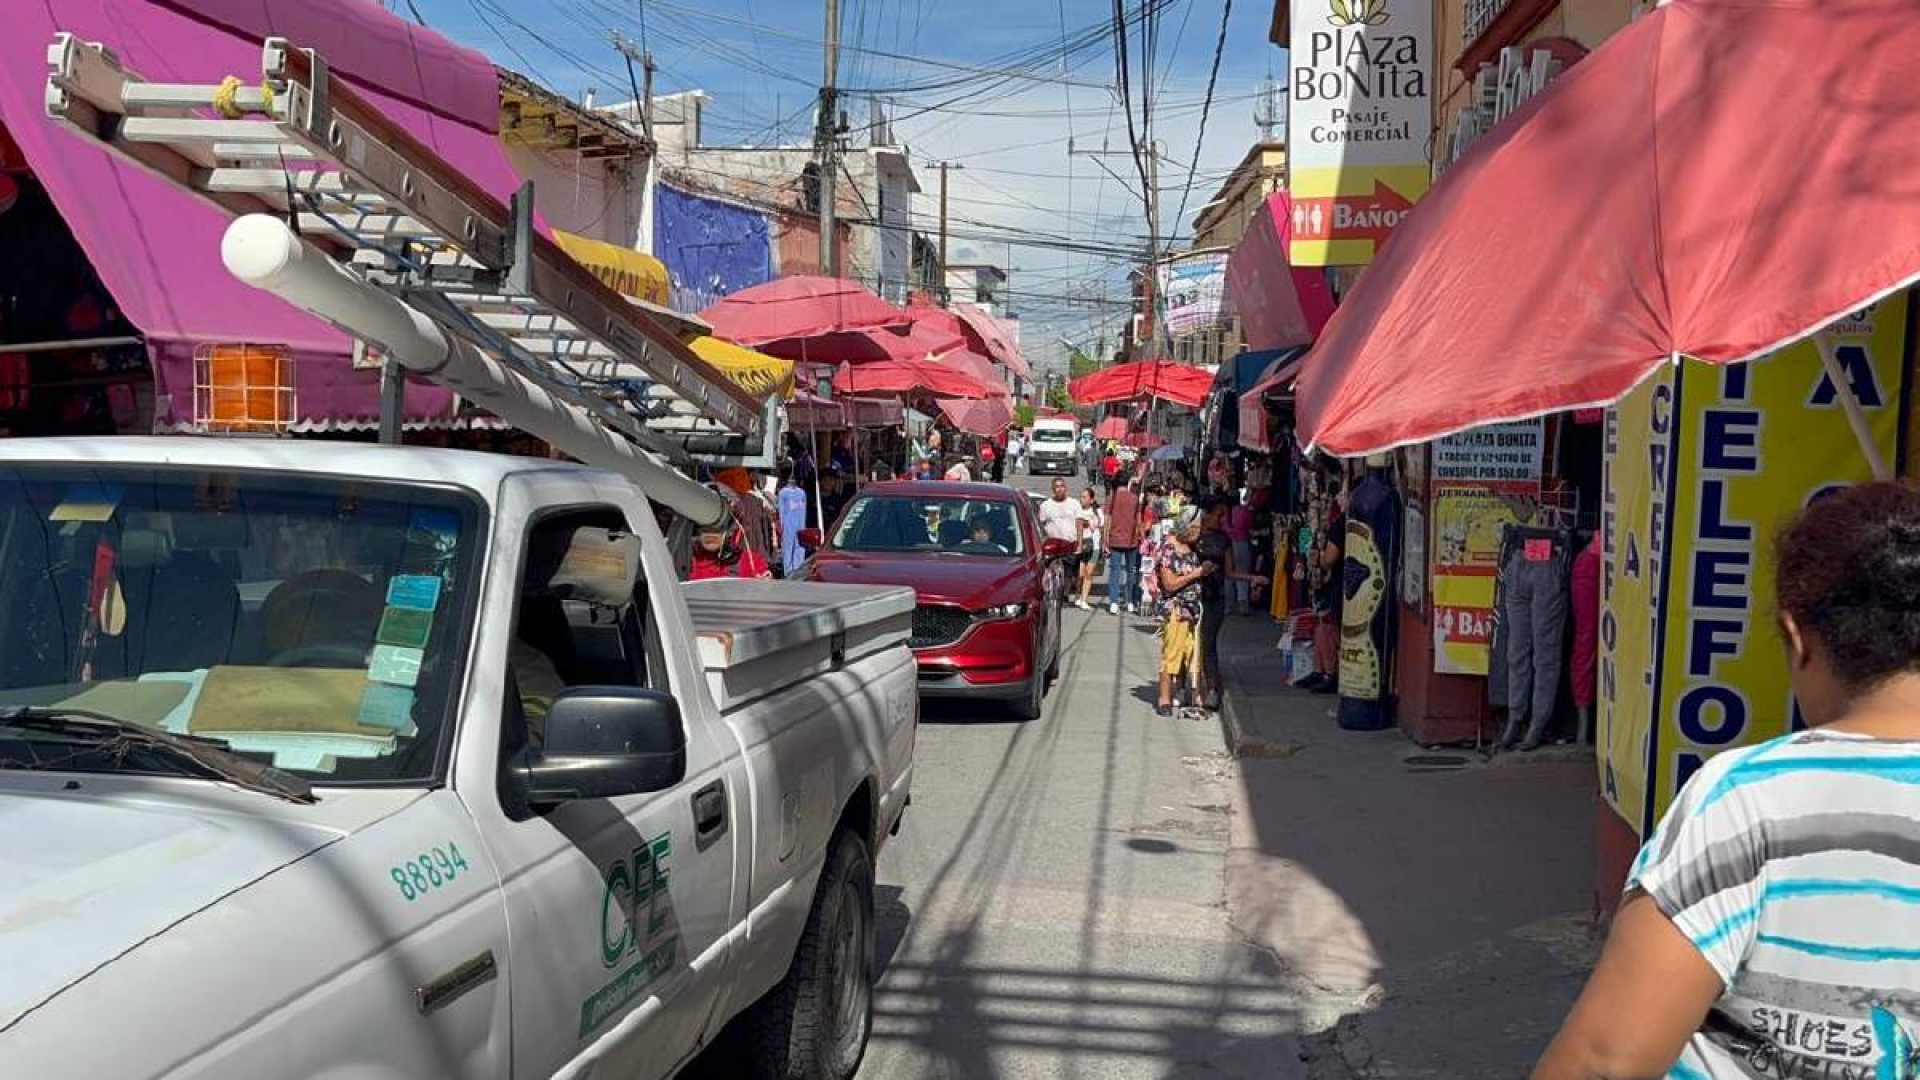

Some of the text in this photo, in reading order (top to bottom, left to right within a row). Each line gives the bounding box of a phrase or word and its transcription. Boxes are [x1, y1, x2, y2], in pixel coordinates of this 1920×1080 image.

[1497, 433, 1537, 447] BONITA
[1624, 534, 1639, 578] A
[390, 843, 468, 901] 88894
[602, 832, 672, 968] CFE
[1751, 1007, 1873, 1057] SHOES
